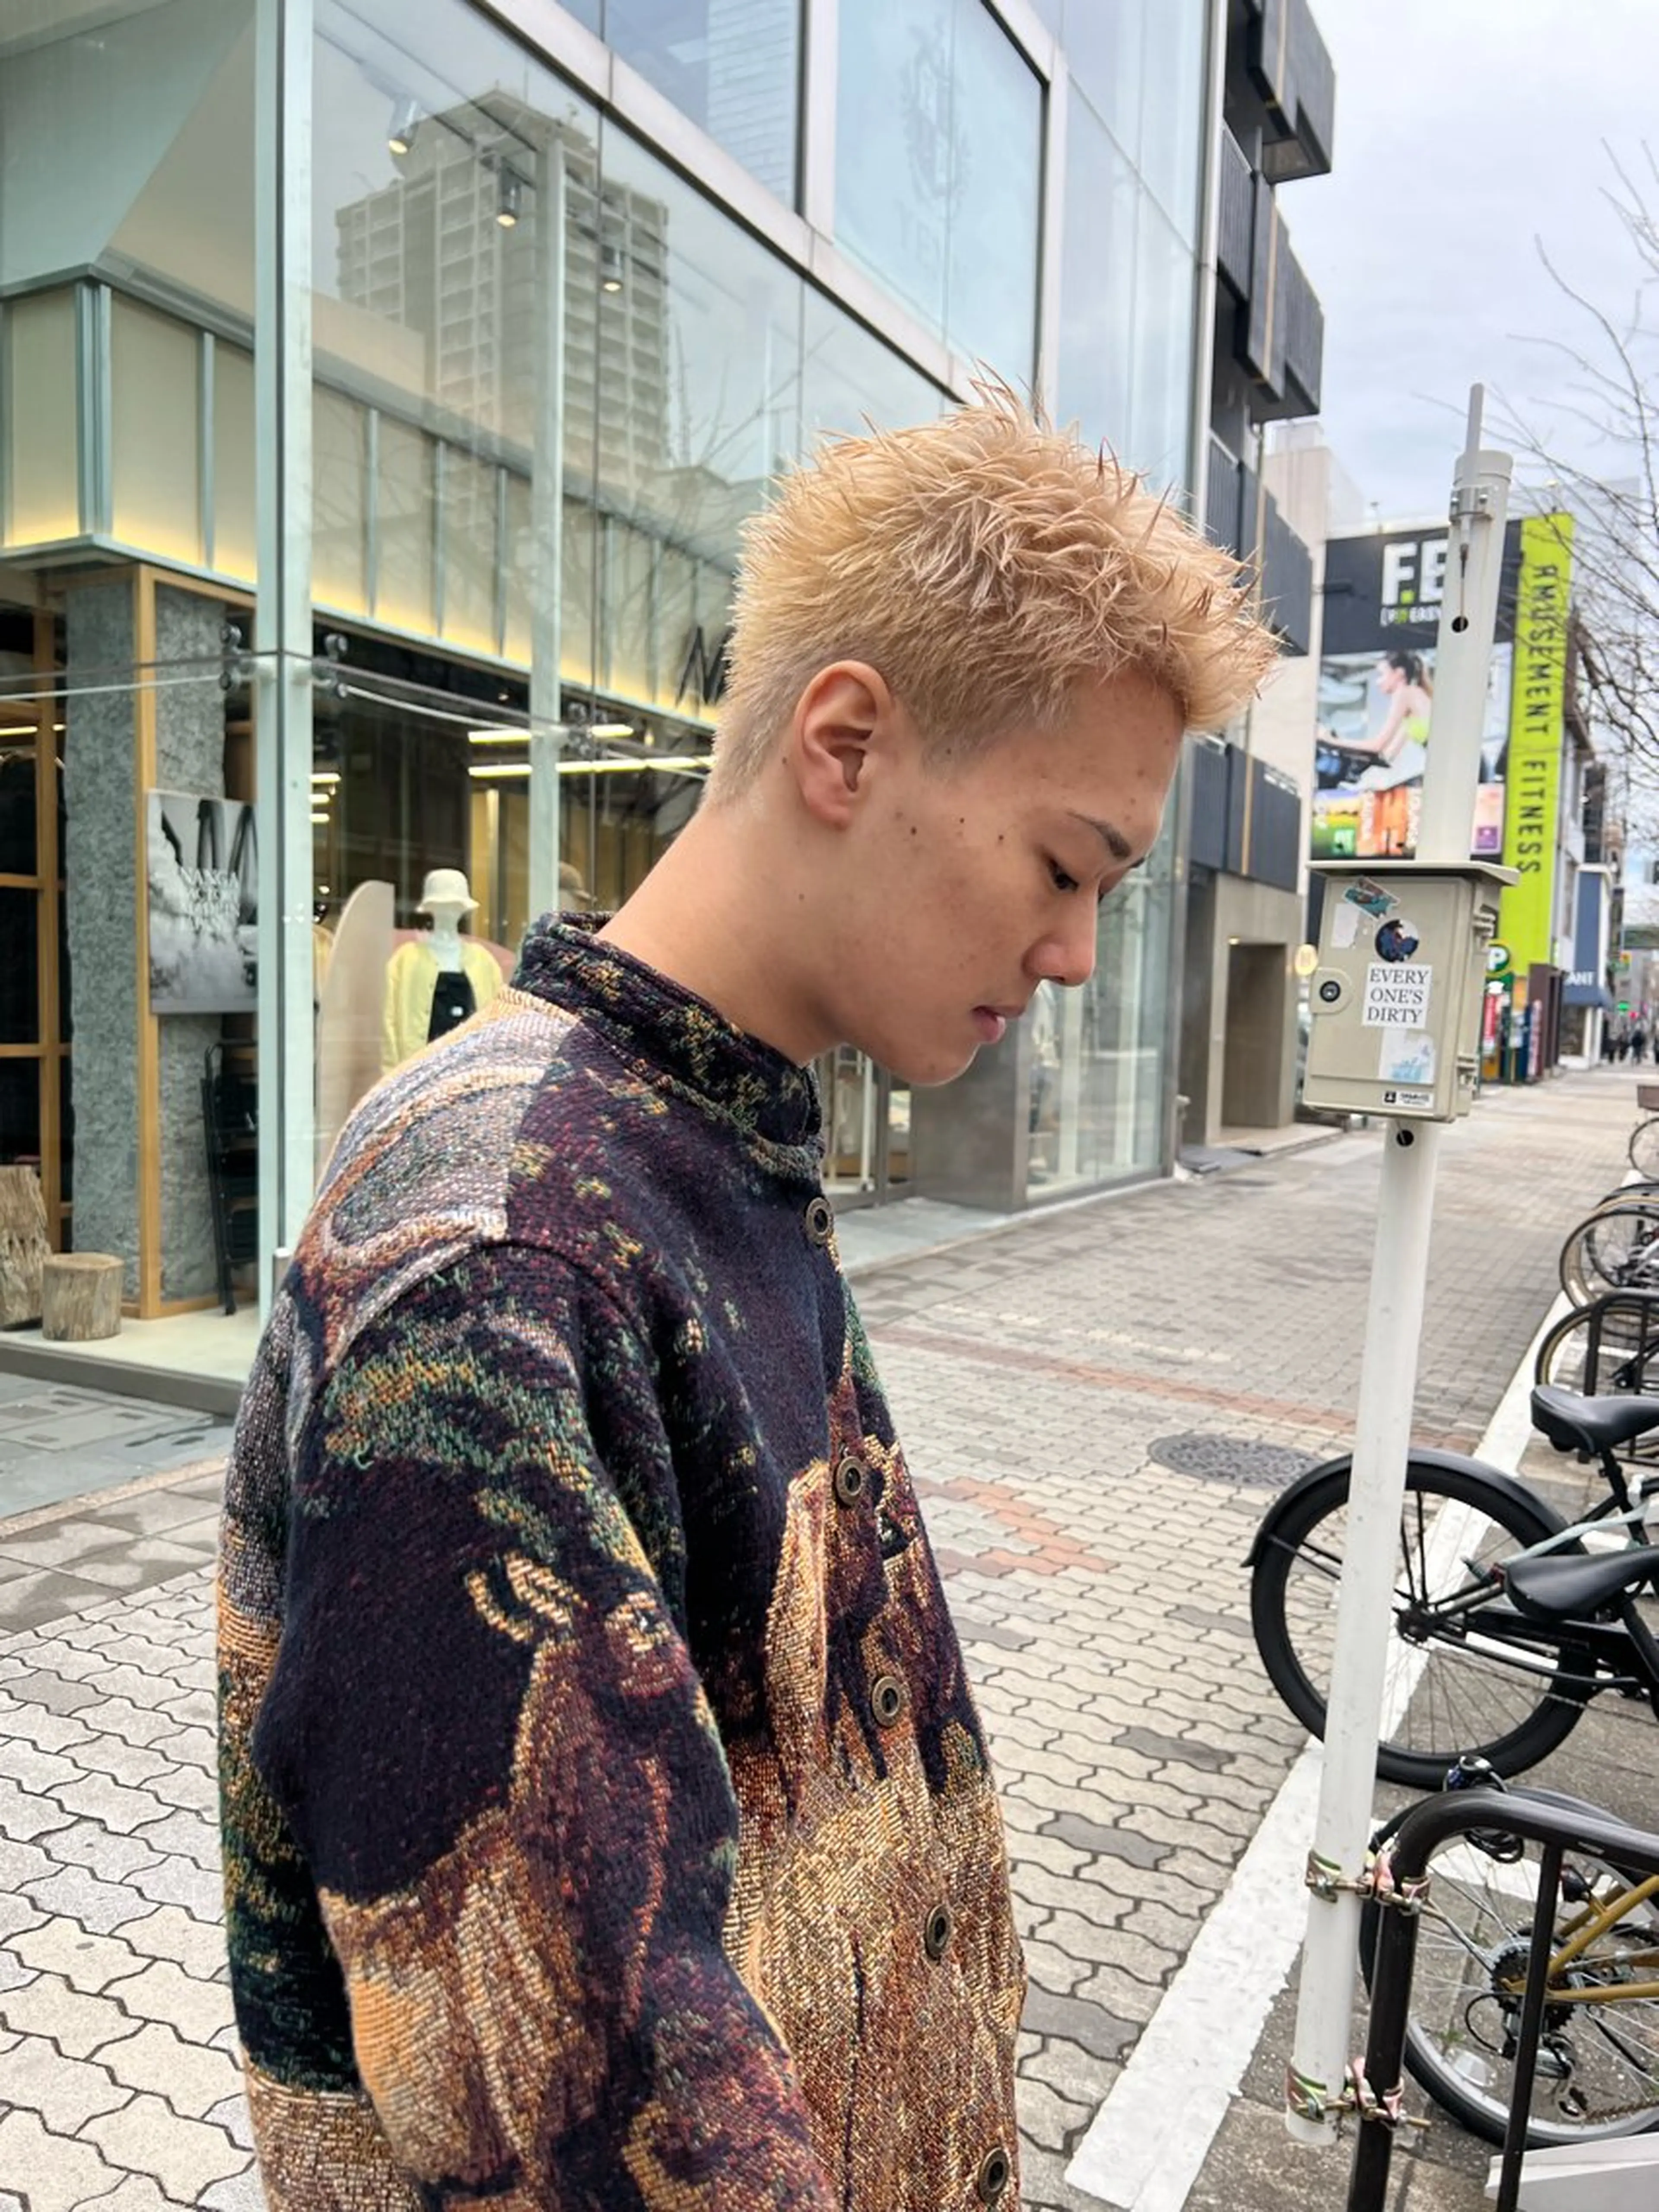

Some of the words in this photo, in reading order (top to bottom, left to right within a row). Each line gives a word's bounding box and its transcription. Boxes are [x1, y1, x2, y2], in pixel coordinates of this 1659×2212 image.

[1525, 566, 1558, 735] AMUSEMENT
[1516, 760, 1547, 873] FITNESS
[1370, 969, 1429, 985] EVERY
[1370, 987, 1424, 1004] ONE'S
[1367, 1006, 1423, 1023] DIRTY
